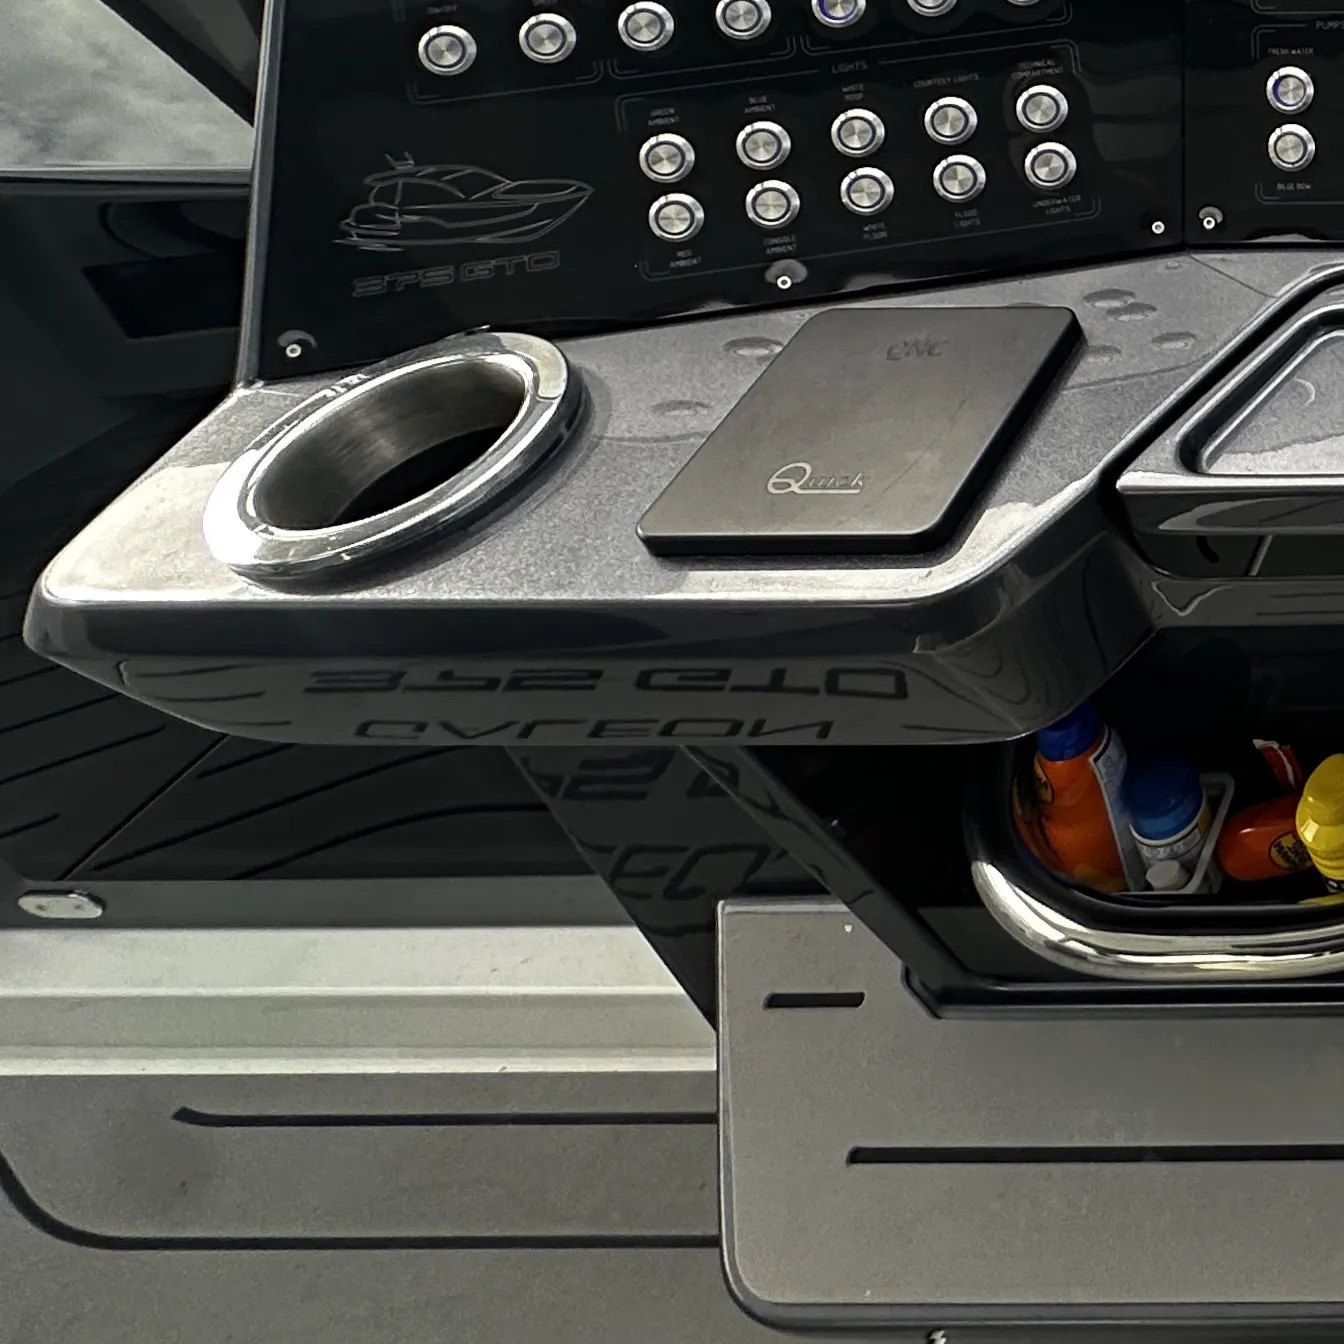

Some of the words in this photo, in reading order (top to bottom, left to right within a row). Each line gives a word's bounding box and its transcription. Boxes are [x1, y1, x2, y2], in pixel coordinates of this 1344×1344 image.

[1268, 47, 1290, 55] FRESH
[831, 60, 868, 74] LIGHTS
[765, 460, 865, 497] Quick
